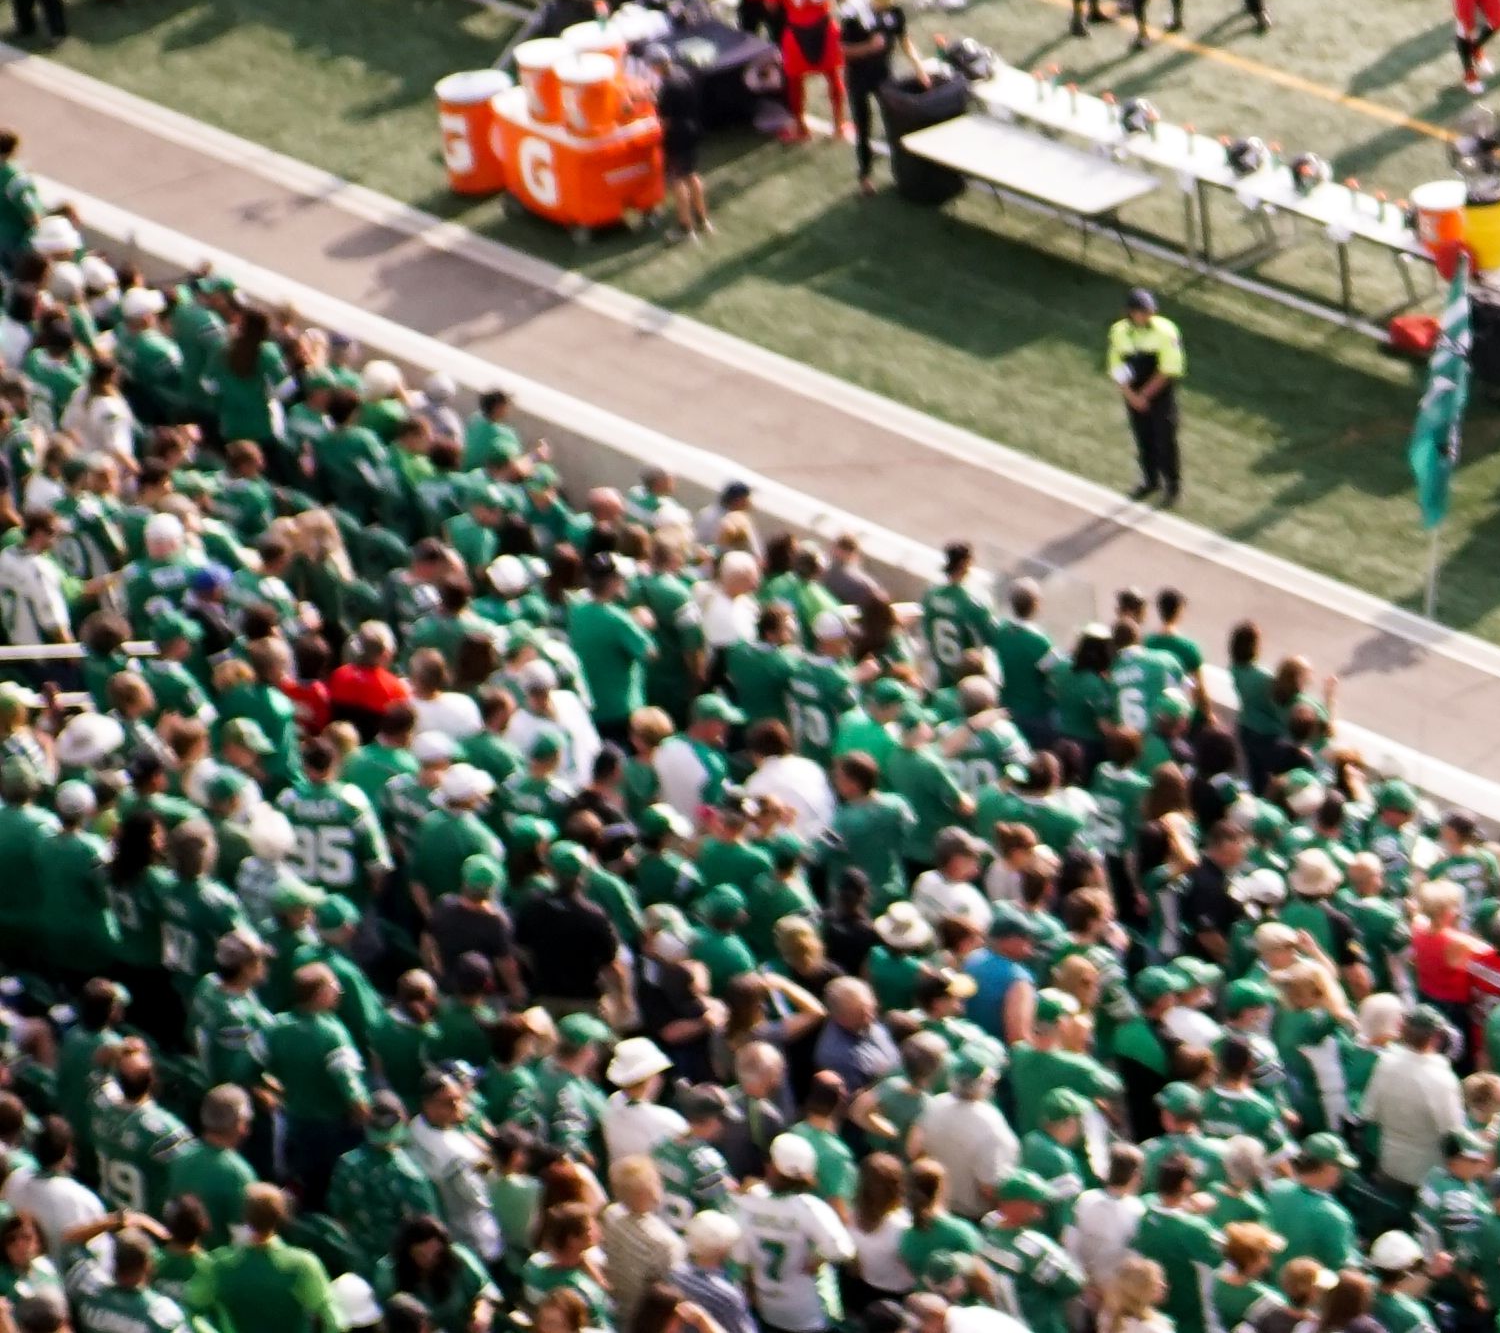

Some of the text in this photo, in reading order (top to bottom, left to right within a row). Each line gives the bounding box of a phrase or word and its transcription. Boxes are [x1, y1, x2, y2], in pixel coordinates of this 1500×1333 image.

[518, 134, 559, 205] G
[932, 618, 962, 666] 6
[1118, 688, 1147, 733] 6
